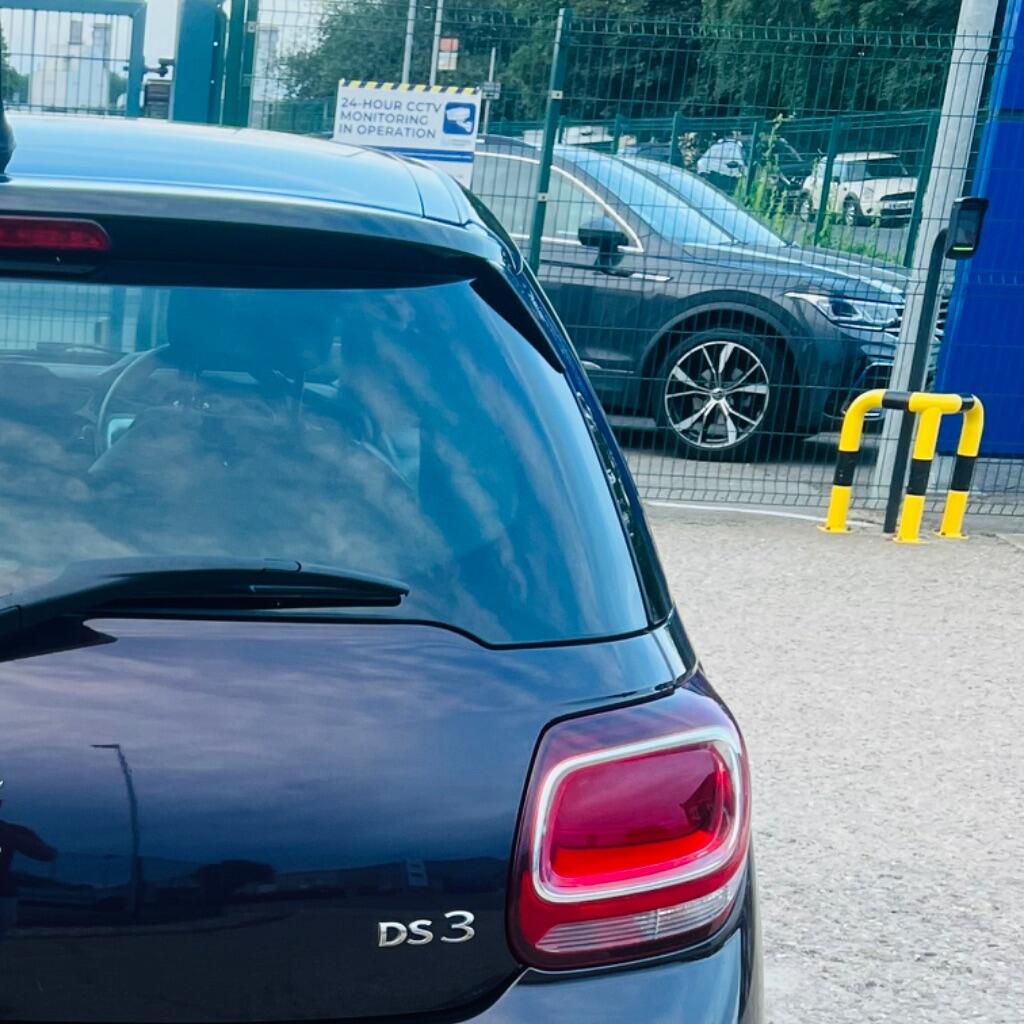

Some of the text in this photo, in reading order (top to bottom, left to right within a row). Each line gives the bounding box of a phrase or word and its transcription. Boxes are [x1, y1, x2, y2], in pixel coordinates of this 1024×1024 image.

[341, 97, 442, 113] 24-HOUR CCTV
[339, 111, 429, 126] MONITORING
[338, 124, 436, 139] IN OPERATION
[378, 910, 475, 947] DS 3
